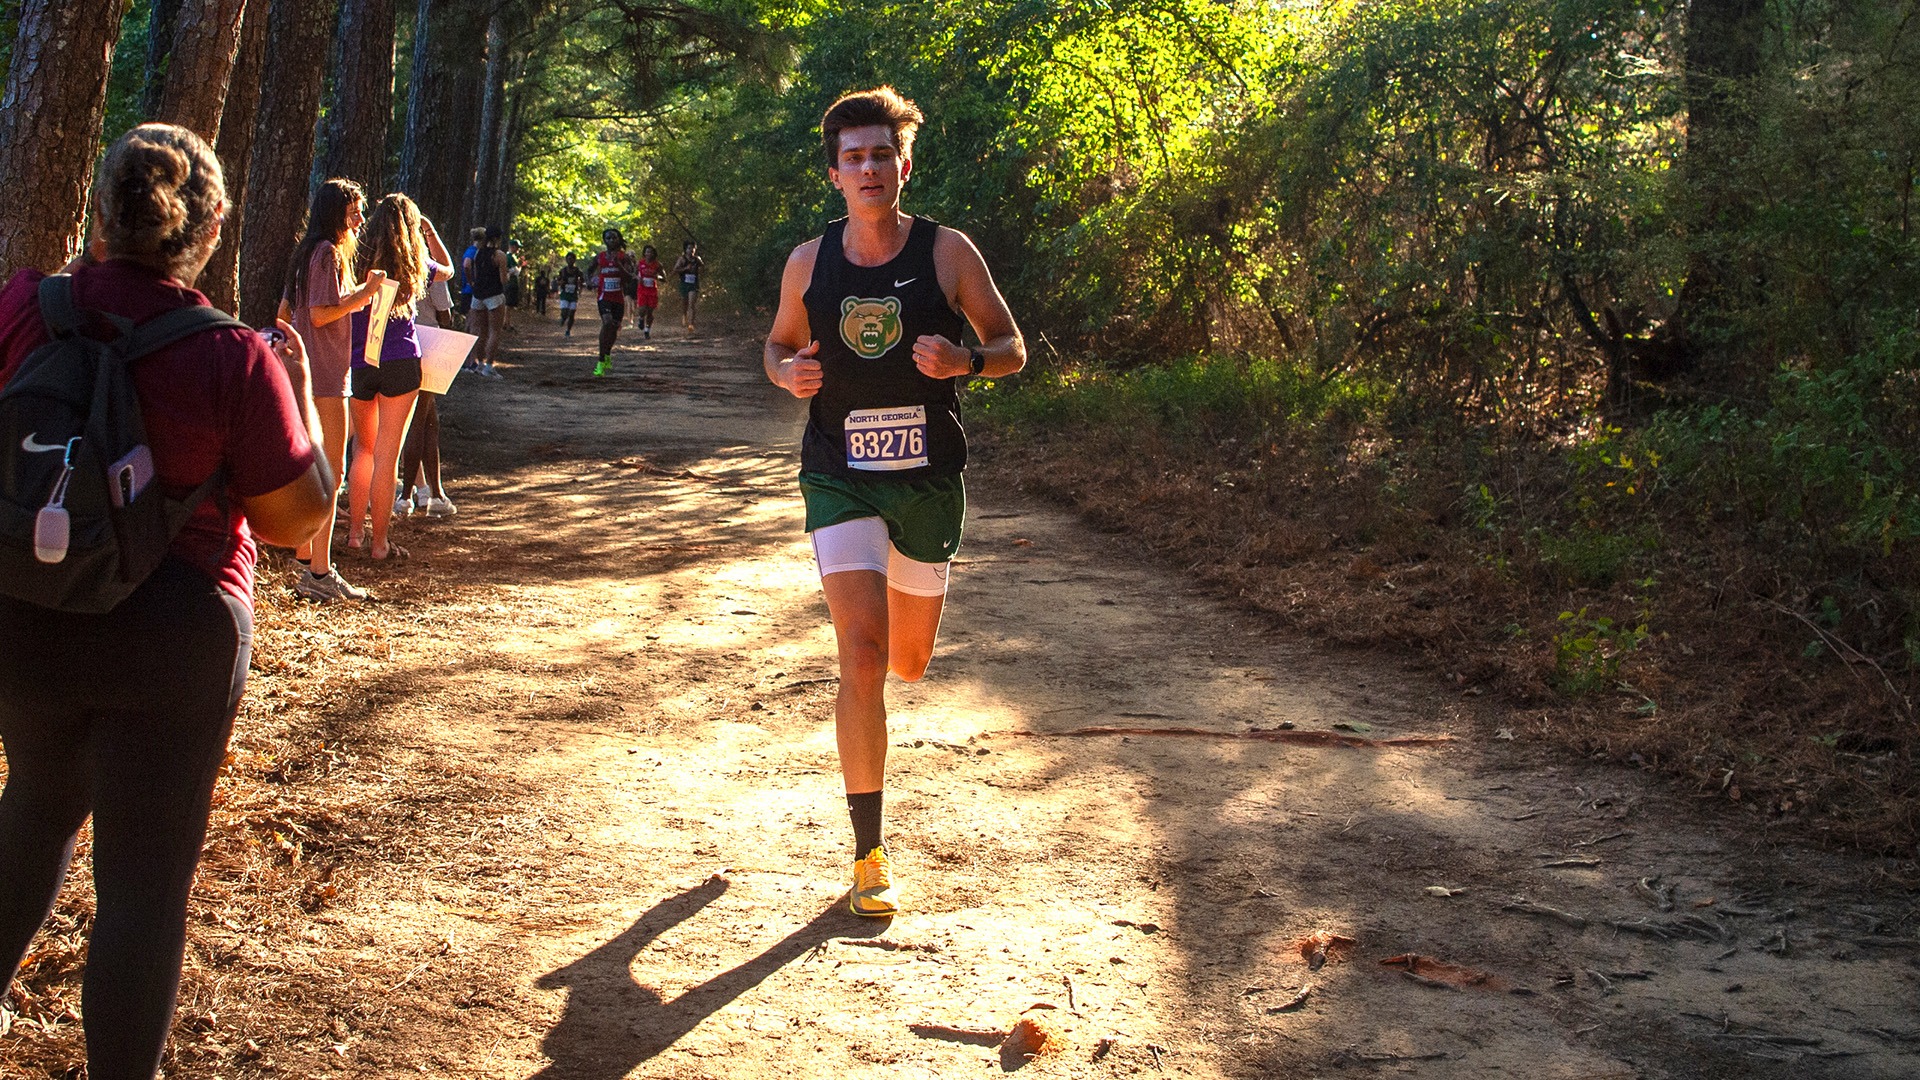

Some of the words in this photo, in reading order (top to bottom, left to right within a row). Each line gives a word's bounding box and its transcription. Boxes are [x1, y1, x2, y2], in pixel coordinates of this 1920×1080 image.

[849, 415, 879, 424] NORTH
[881, 412, 919, 422] GEORGIA
[850, 428, 923, 459] 83276
